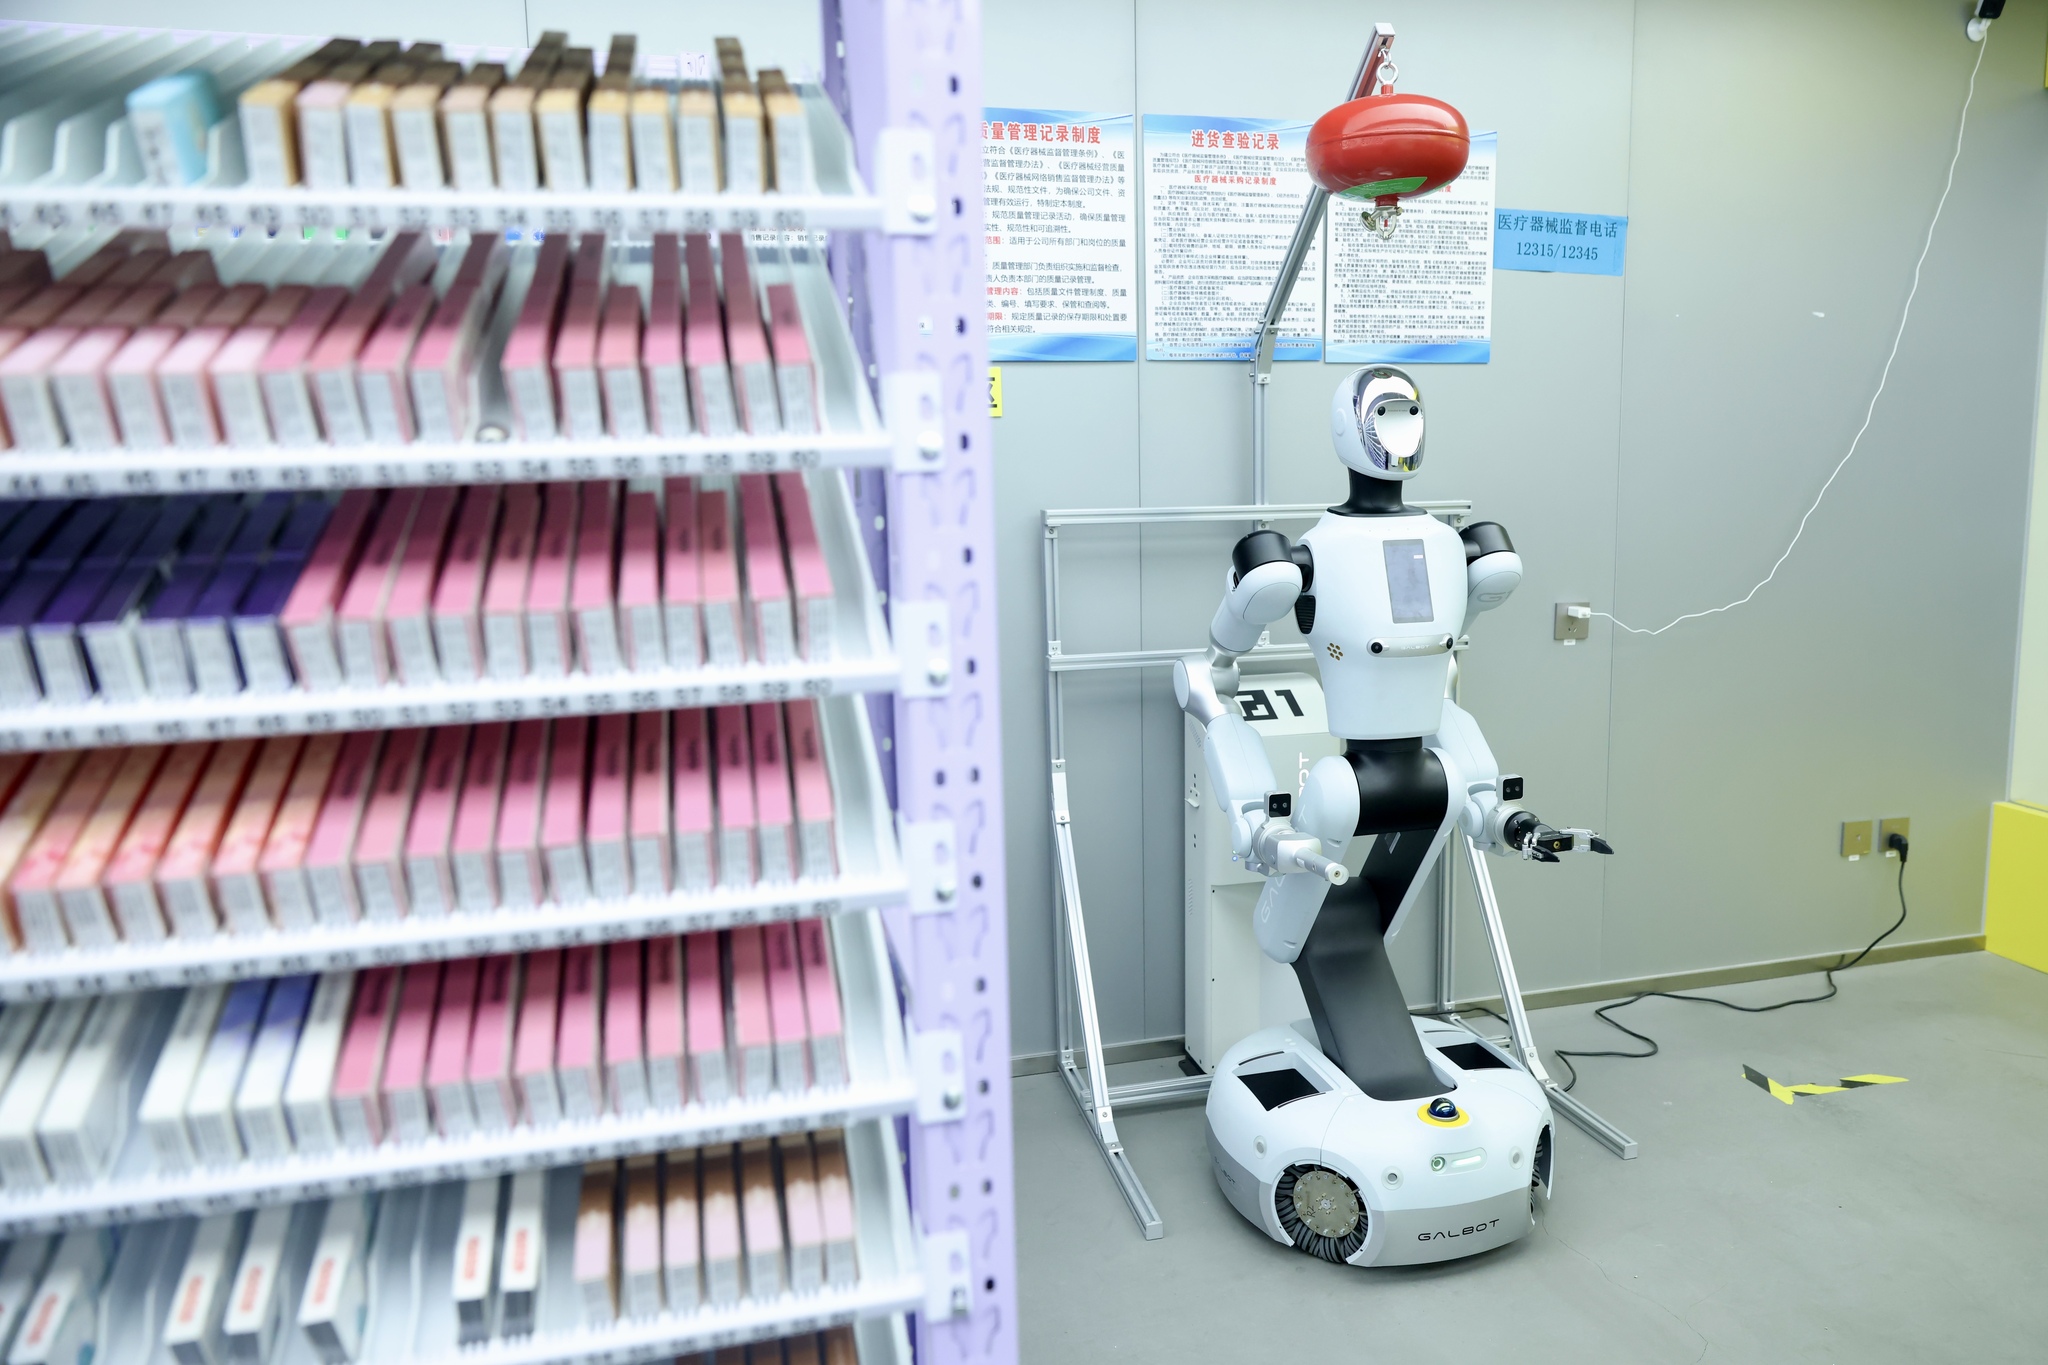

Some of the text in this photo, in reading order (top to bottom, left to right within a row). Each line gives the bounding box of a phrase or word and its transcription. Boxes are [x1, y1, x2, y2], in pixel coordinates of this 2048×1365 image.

[1191, 131, 1280, 150] 进货查验记录
[1194, 175, 1277, 186] 医疗器械采购记录制度
[1497, 213, 1618, 238] 医疗器械监督电话
[1516, 241, 1599, 261] 12315/12345
[1417, 1218, 1500, 1241] GALBOT
